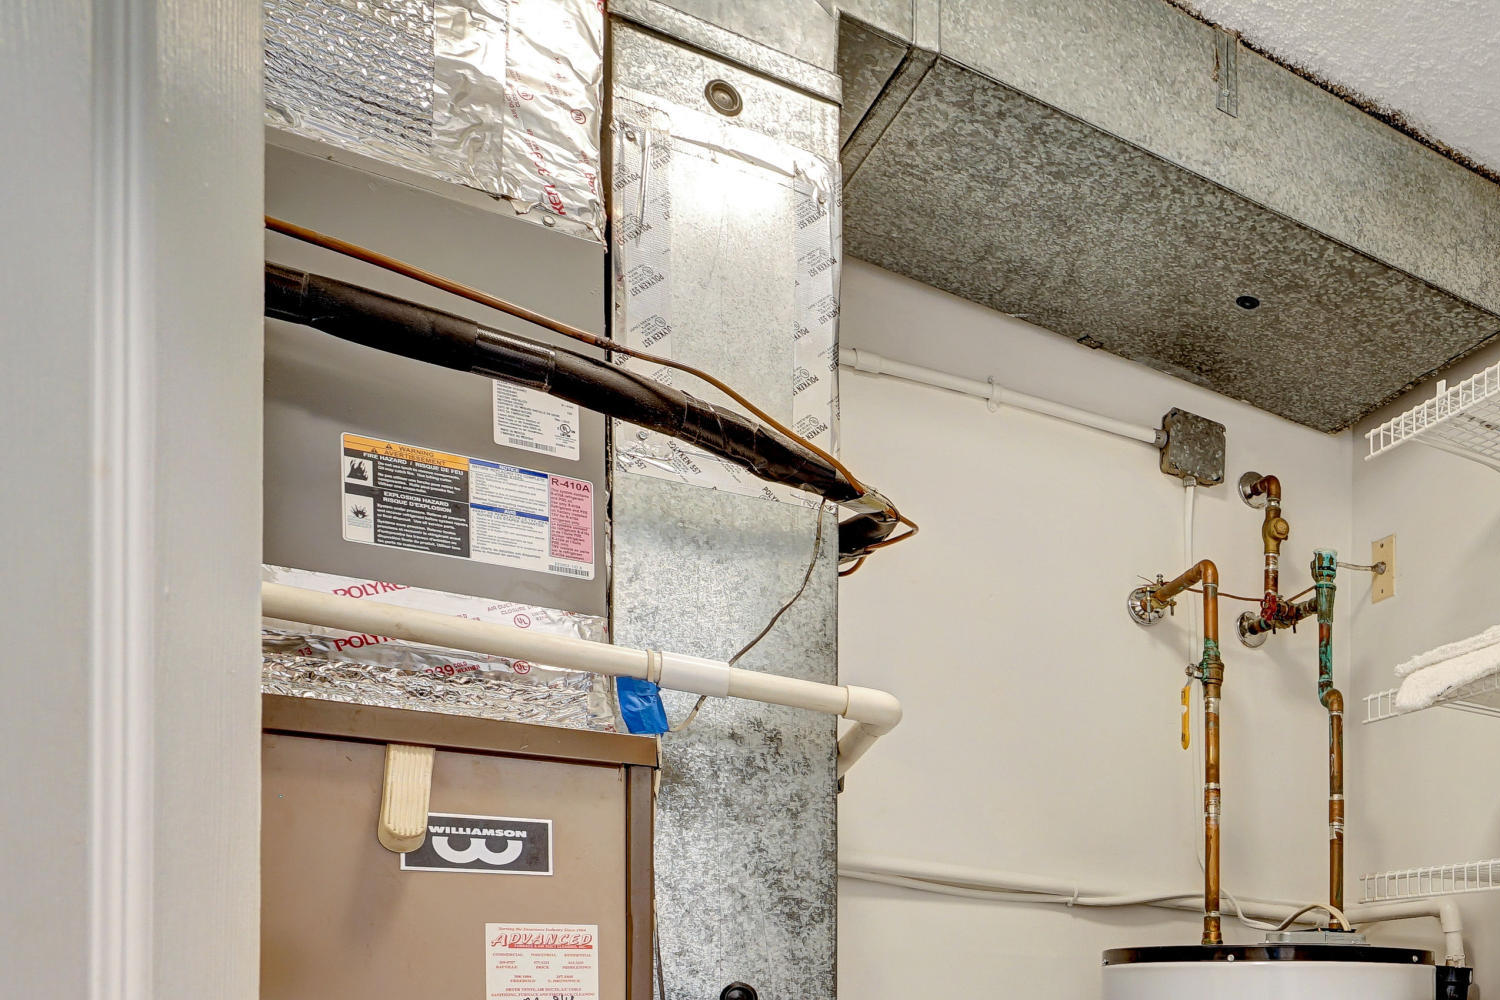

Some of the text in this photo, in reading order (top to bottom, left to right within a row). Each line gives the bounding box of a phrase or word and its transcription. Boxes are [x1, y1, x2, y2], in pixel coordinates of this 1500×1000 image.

[640, 273, 665, 291] POLYKEN
[398, 446, 435, 458] WARNING
[363, 452, 379, 460] FIRE
[379, 455, 408, 465] HAZARD
[415, 461, 440, 471] RISQUE
[551, 478, 590, 493] R-410A
[383, 491, 450, 507] EXPLOSION HAZARD
[383, 496, 408, 506] RISQUE
[428, 825, 527, 838] WILLIAMSON
[491, 933, 593, 948] ADVANCED
